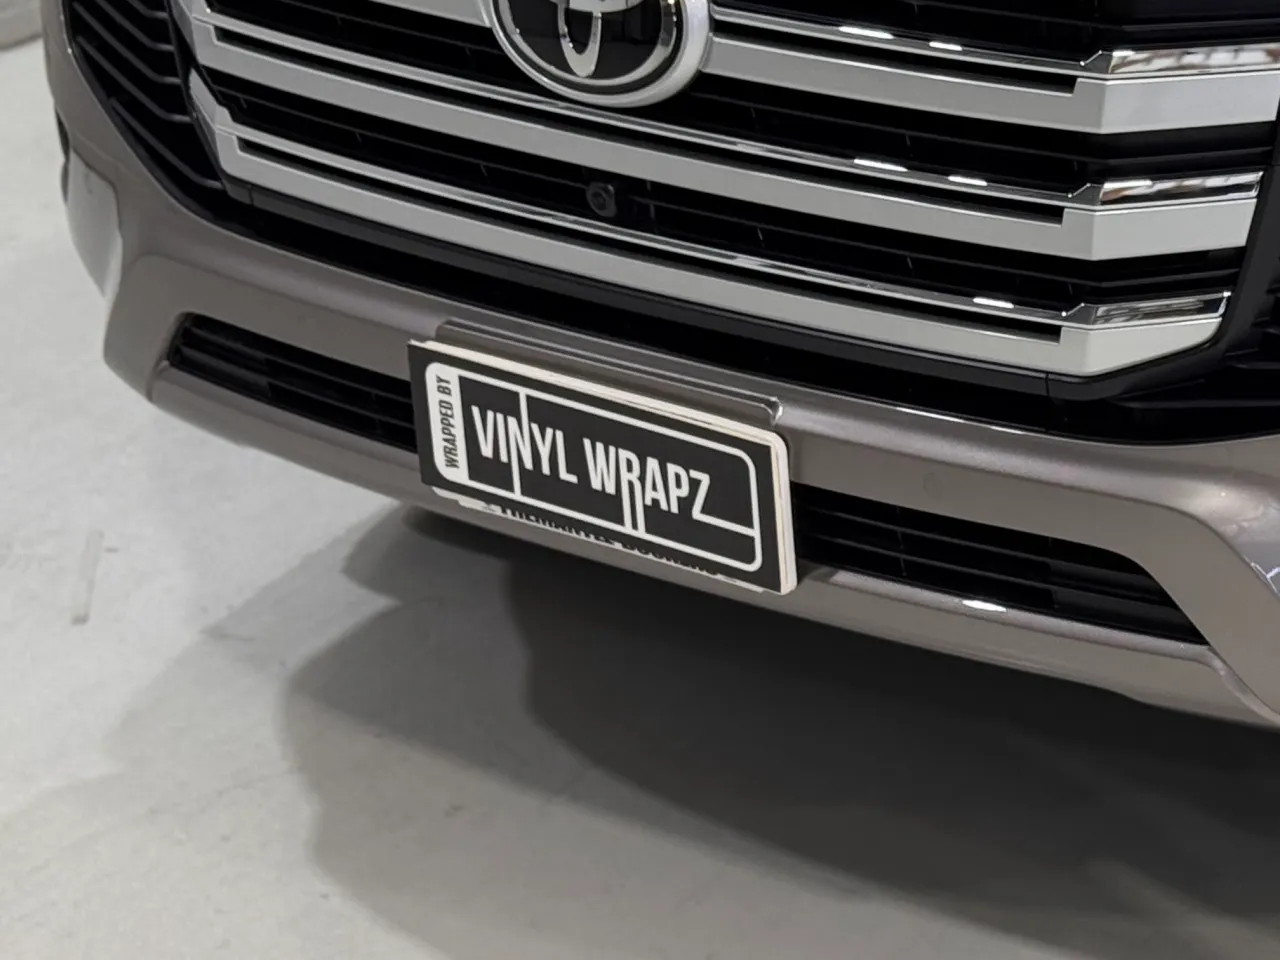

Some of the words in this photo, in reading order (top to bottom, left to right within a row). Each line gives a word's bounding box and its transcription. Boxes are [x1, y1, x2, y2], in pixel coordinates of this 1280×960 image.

[435, 374, 453, 397] BY
[438, 399, 461, 470] WRAPPED
[470, 398, 579, 490] VINYL
[582, 437, 712, 526] WRAPZ
